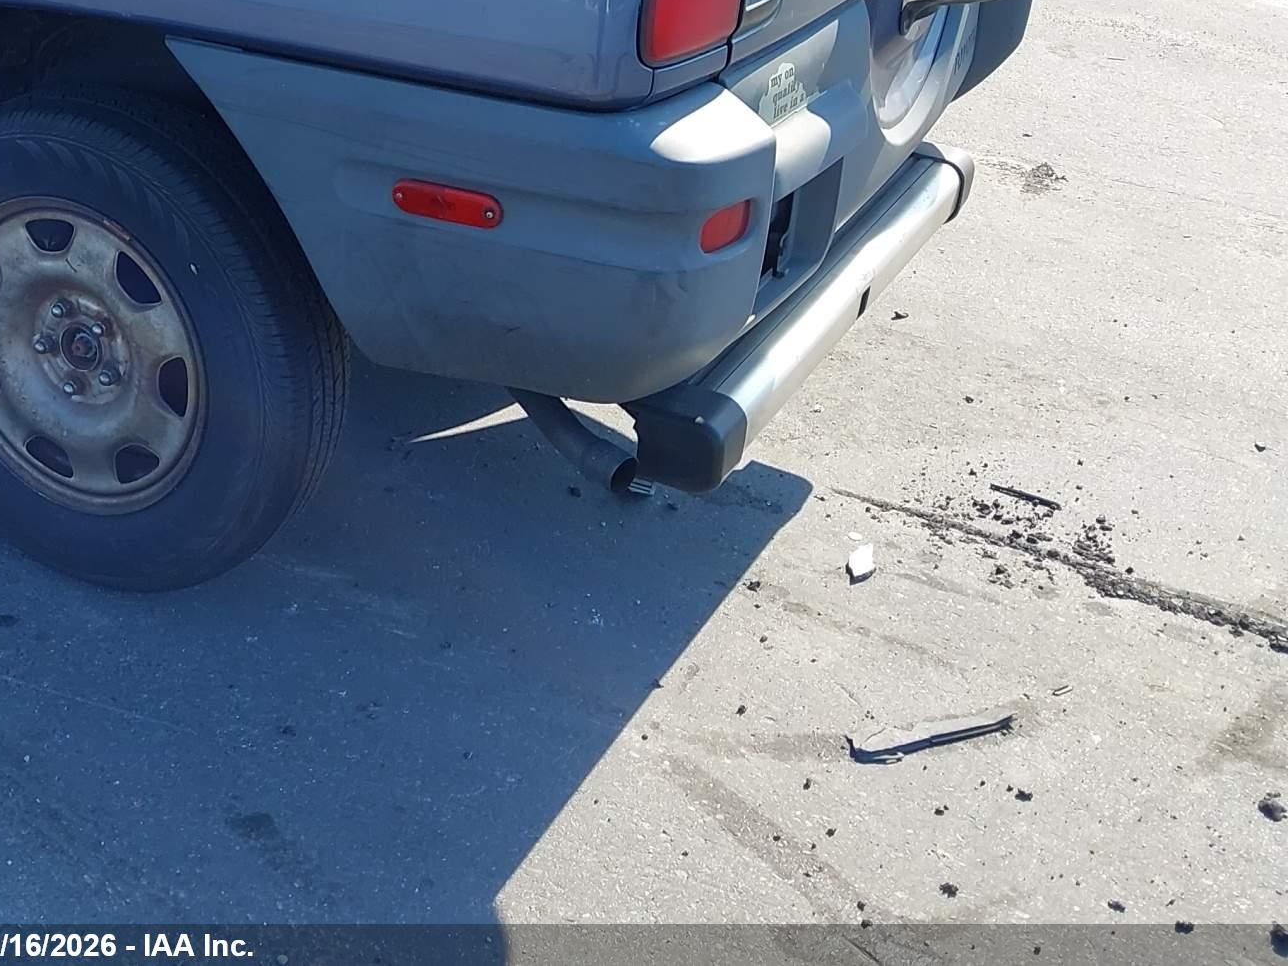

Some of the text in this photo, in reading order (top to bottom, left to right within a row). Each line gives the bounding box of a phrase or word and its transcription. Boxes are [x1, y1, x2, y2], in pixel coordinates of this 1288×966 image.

[770, 67, 794, 88] my on
[790, 96, 798, 109] in
